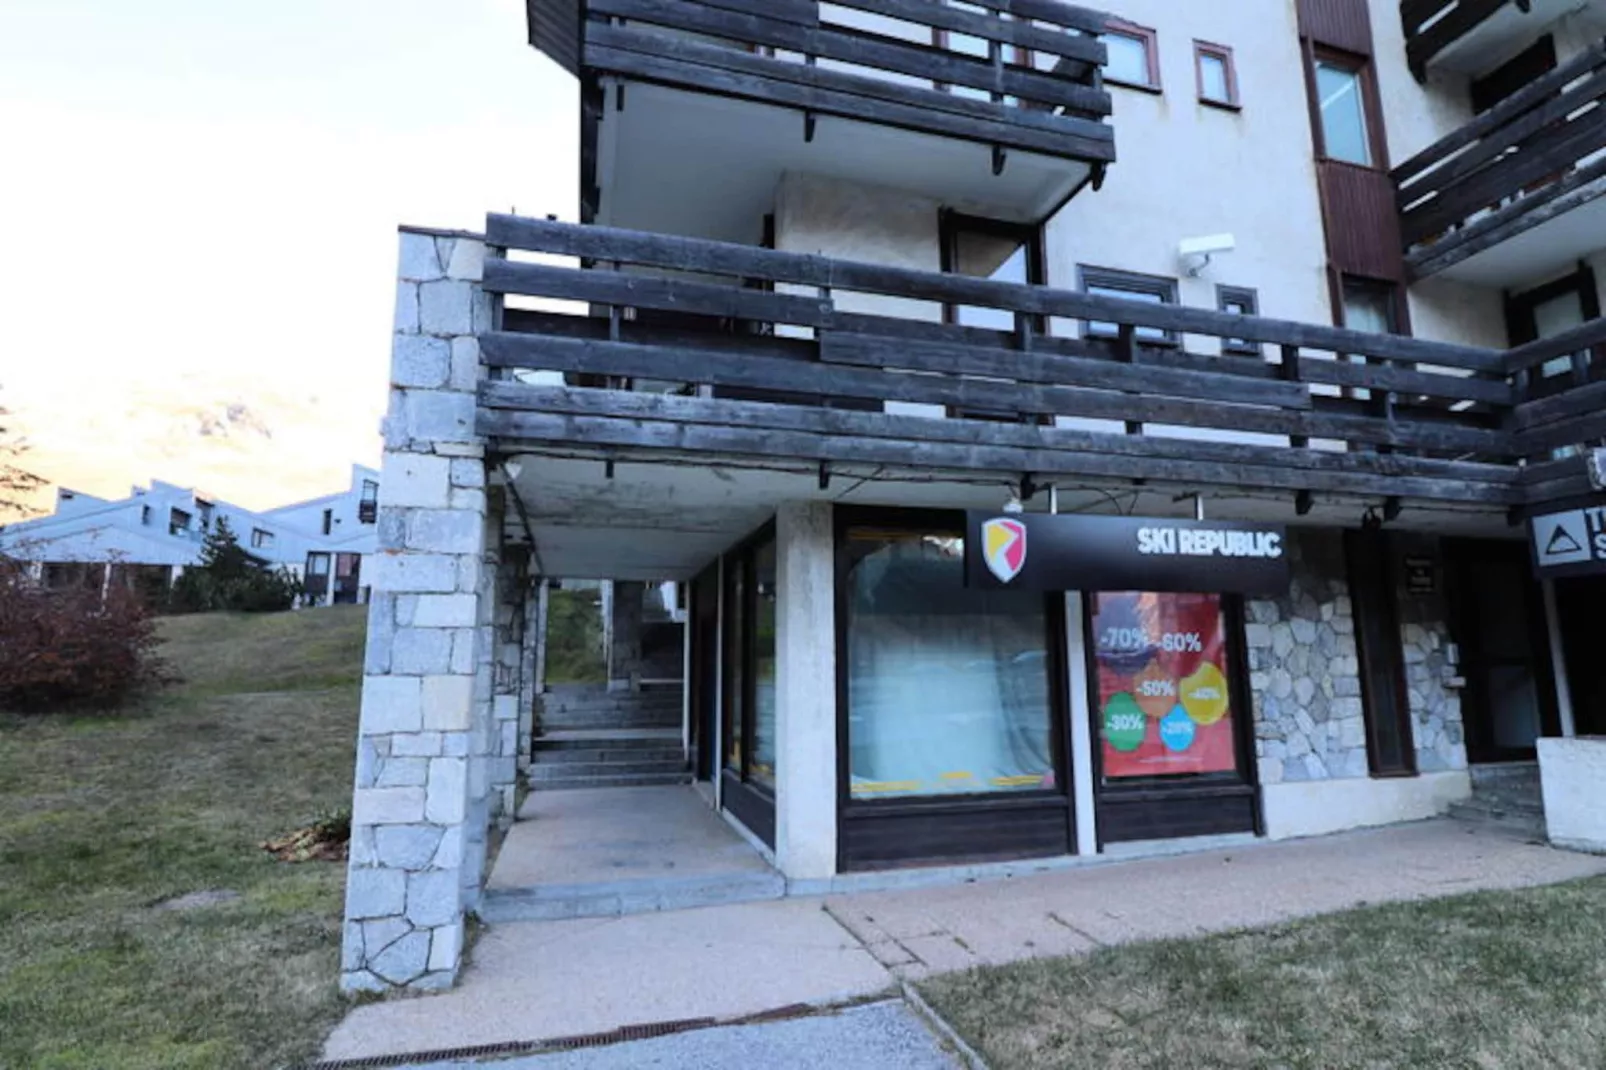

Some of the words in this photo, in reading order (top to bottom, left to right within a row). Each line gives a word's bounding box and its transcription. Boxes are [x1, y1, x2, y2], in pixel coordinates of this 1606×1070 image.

[1137, 527, 1176, 554] SKI
[1179, 528, 1282, 557] REPUBLIC
[1101, 626, 1149, 649] -70%
[1106, 713, 1145, 731] -30%
